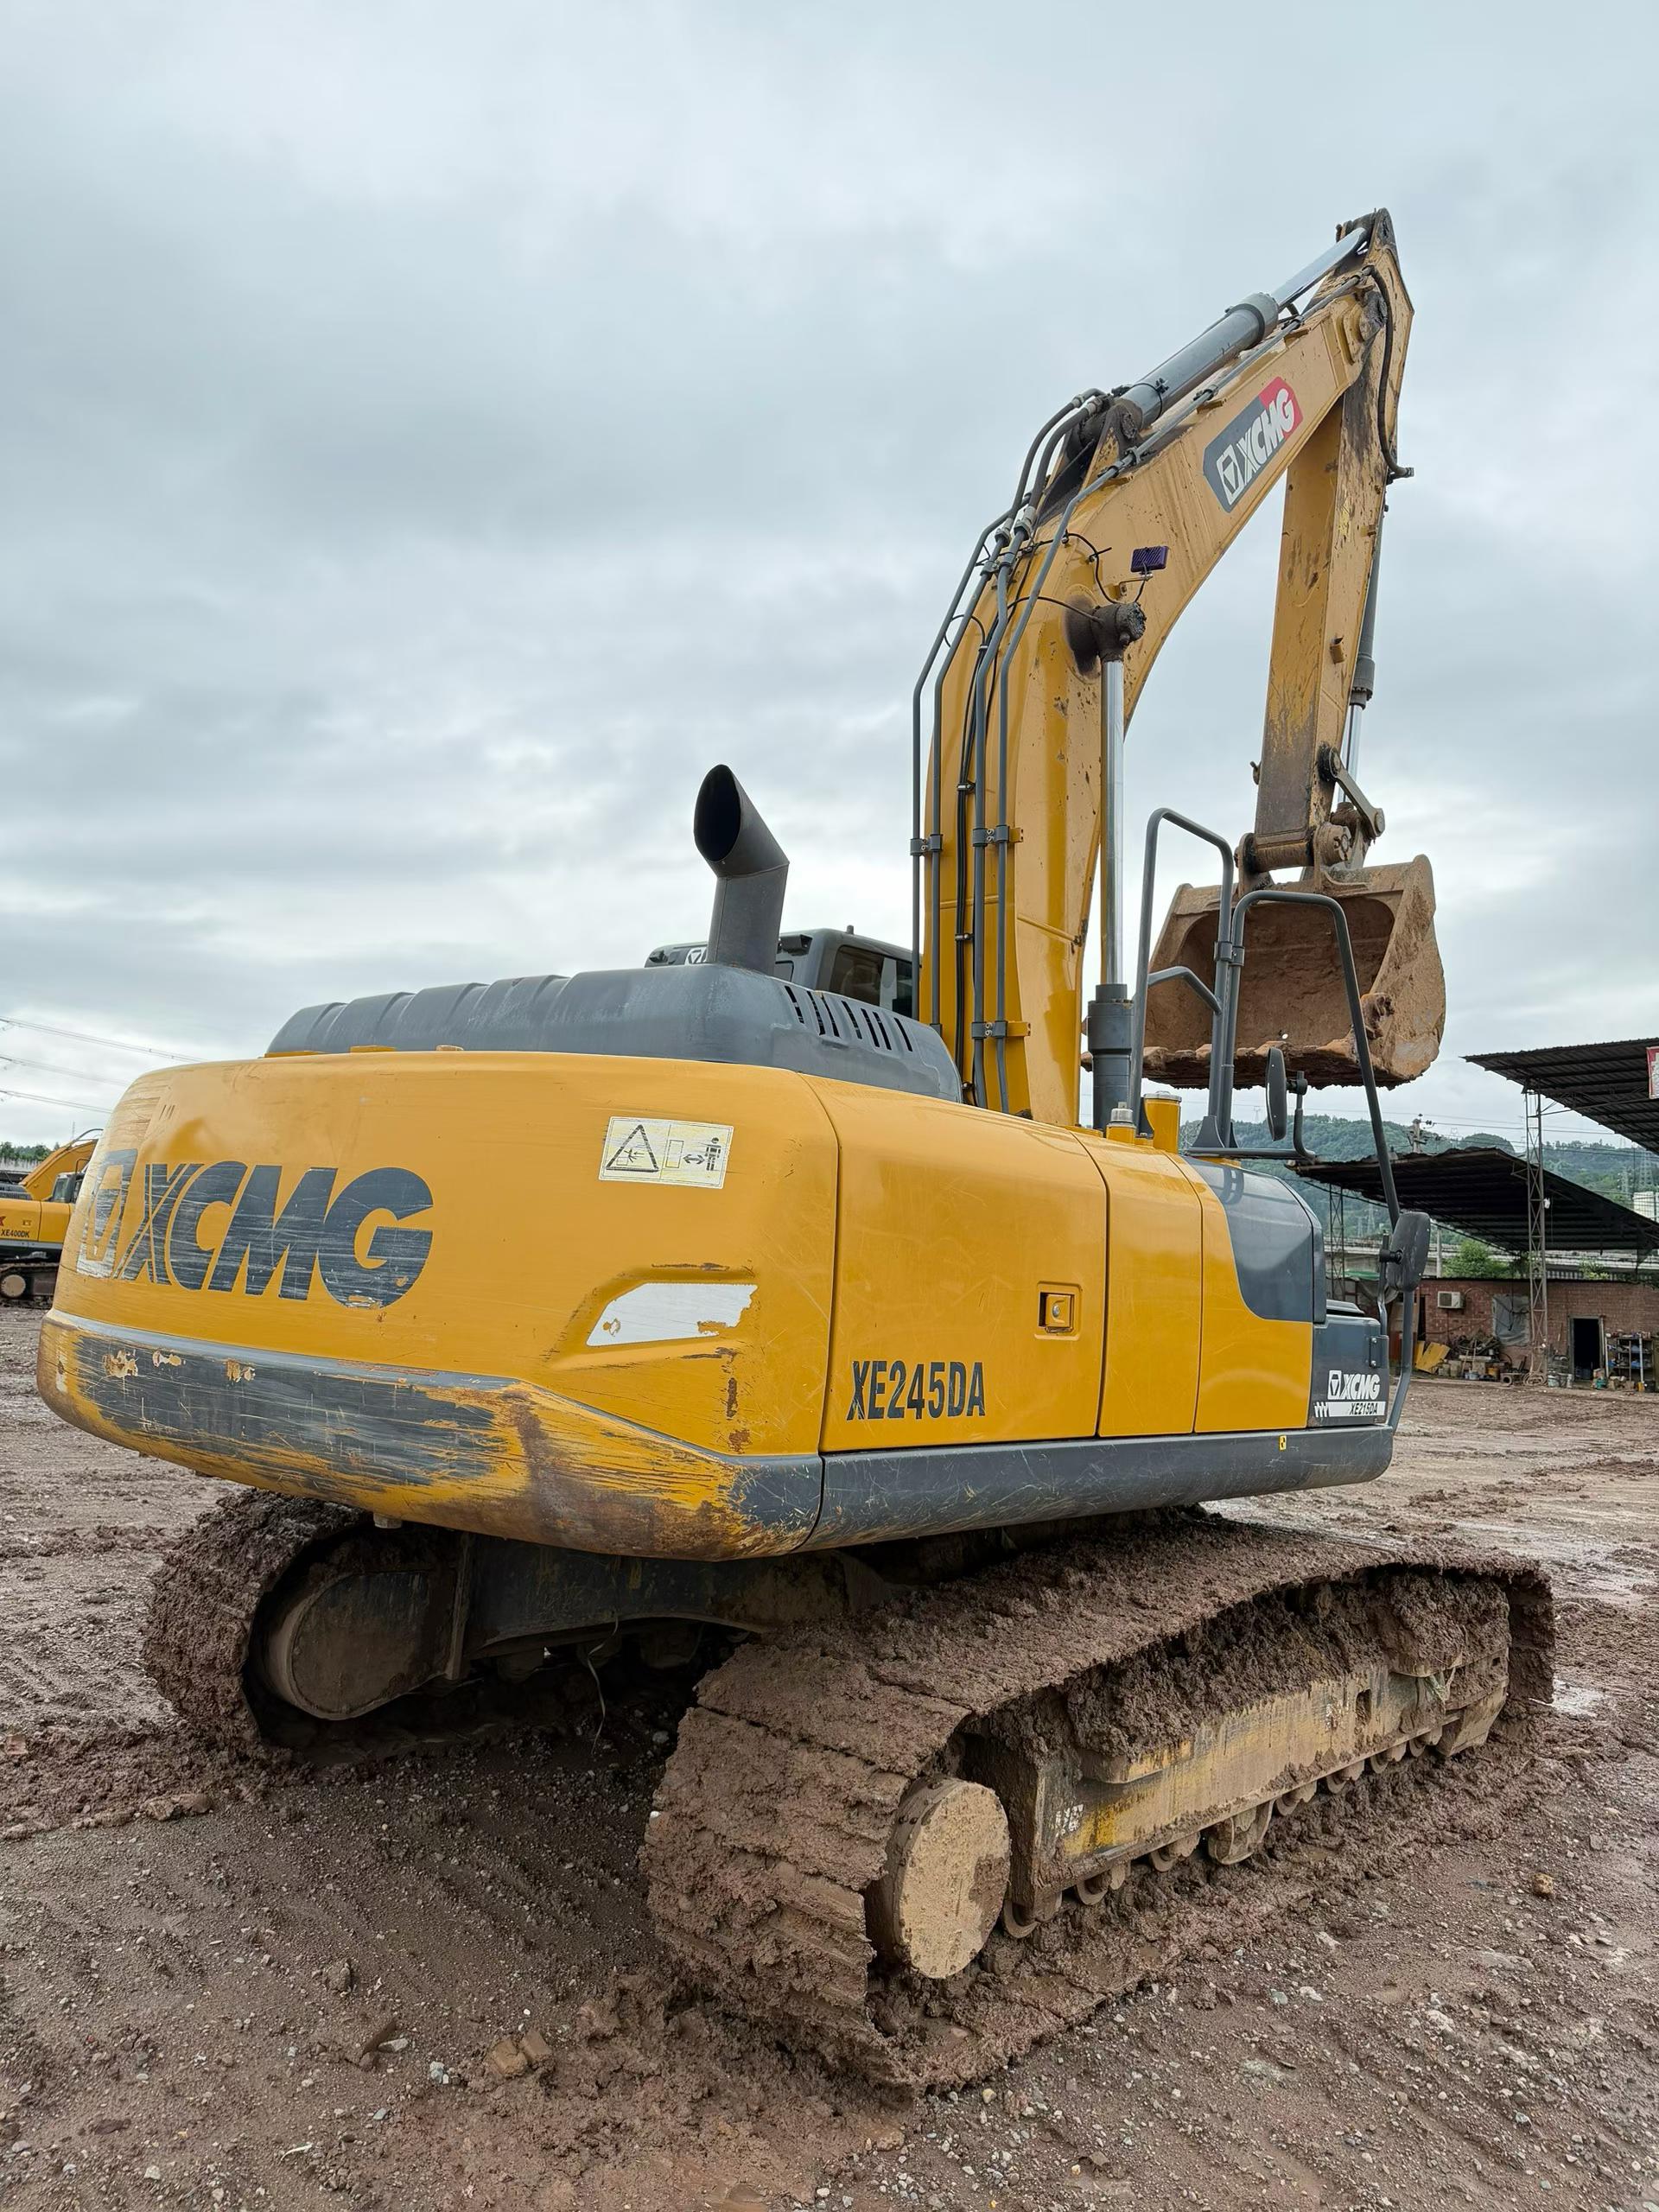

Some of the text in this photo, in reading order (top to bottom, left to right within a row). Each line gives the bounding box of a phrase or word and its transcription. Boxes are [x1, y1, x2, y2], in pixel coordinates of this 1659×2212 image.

[1236, 388, 1294, 486] XCMG
[115, 1160, 433, 1310] XCMG
[846, 1360, 986, 1421] XE245DA
[1340, 1373, 1381, 1400] XCMG
[1349, 1402, 1378, 1415] XE215DA
